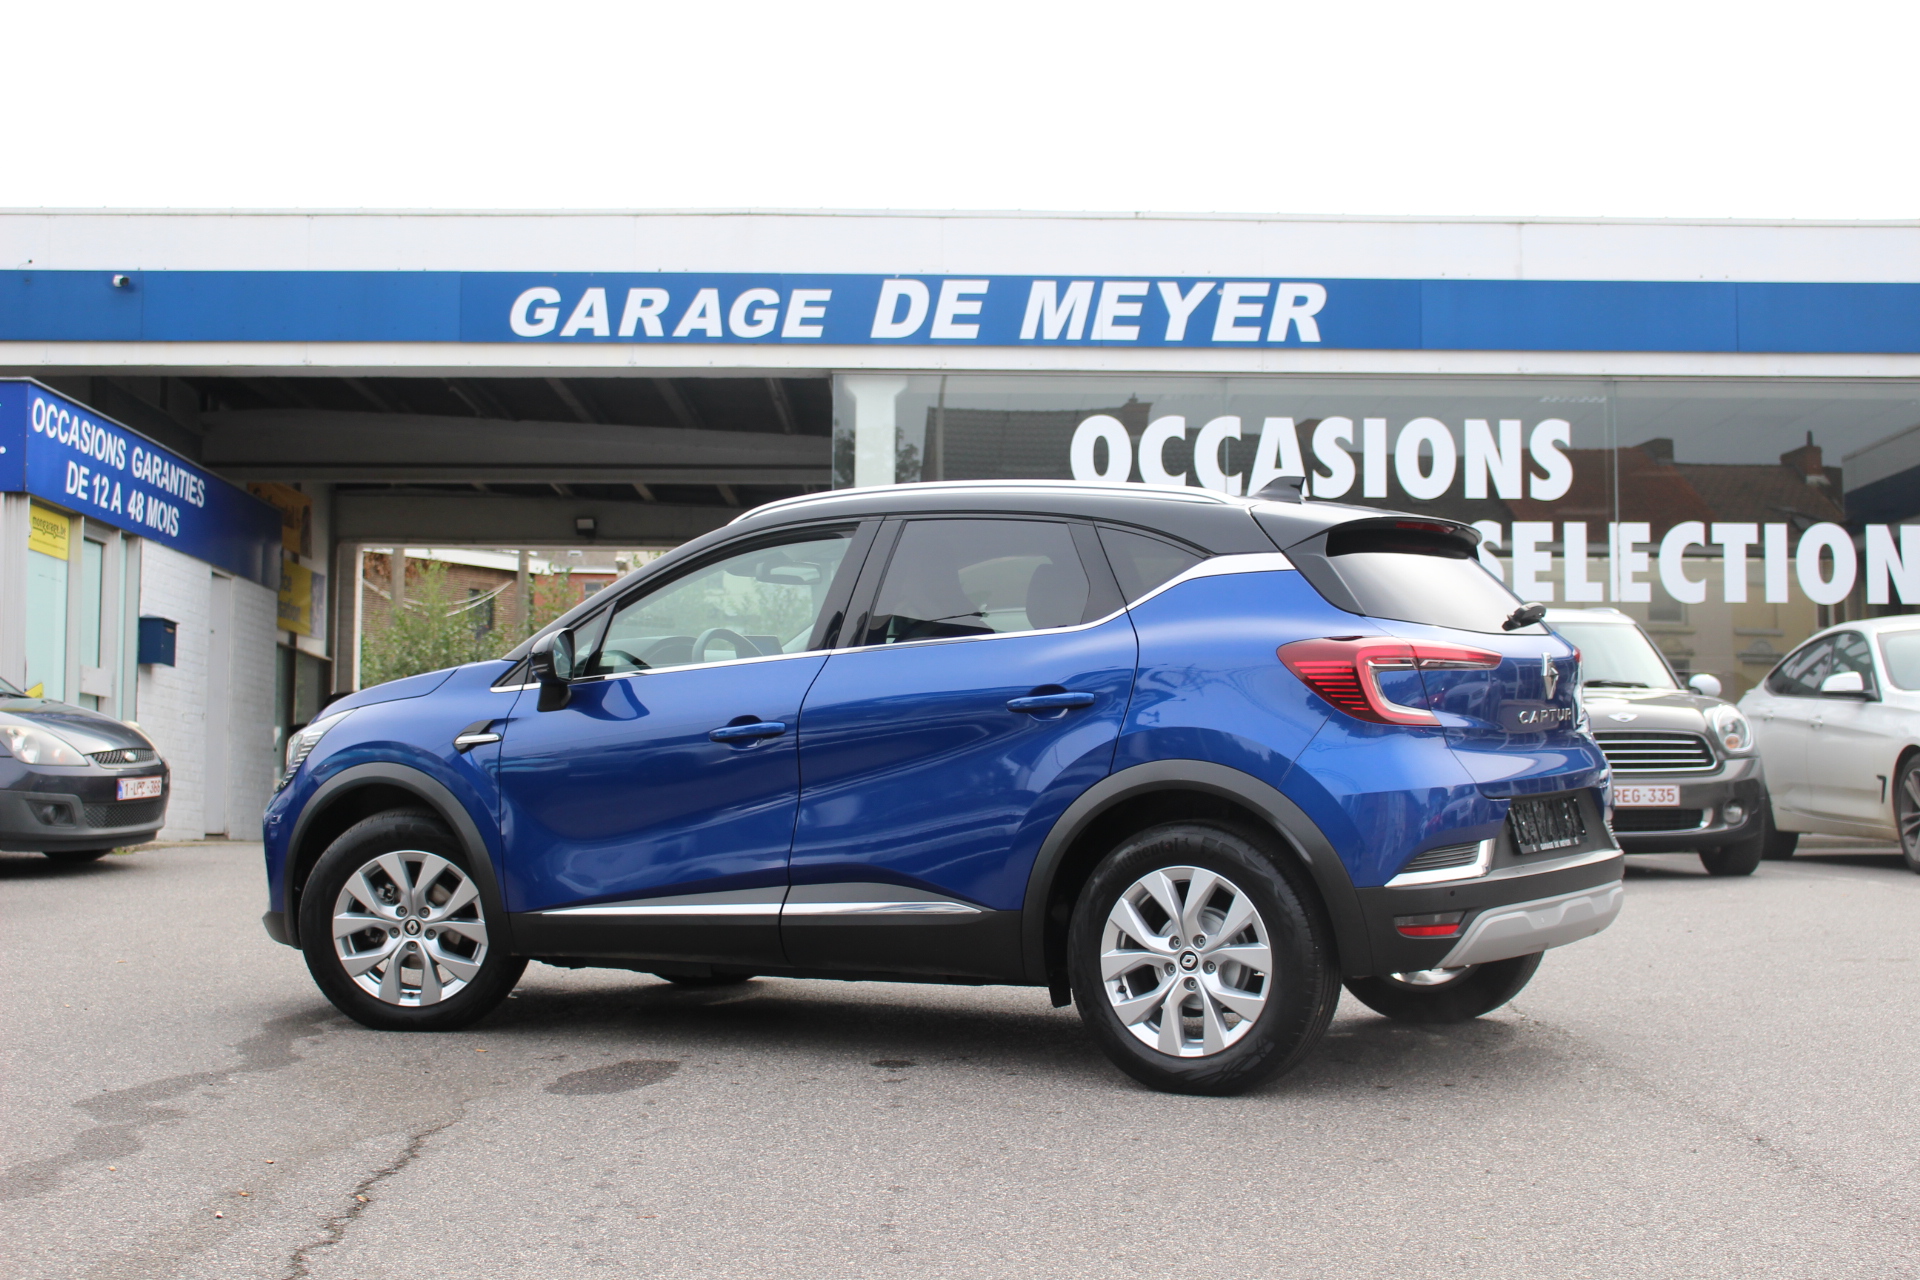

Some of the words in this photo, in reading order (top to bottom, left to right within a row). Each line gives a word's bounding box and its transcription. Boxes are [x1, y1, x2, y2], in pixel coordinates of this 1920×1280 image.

[509, 286, 833, 338] GARAGE
[869, 278, 990, 340] DE
[1018, 280, 1328, 343] MEYER
[31, 396, 127, 471] OCCASIONS
[131, 446, 206, 508] GARANTIES
[1070, 415, 1574, 501] OCCASIONS
[65, 460, 90, 500] DE
[92, 473, 109, 509] 12
[110, 482, 122, 515] A
[127, 488, 145, 523] 48
[146, 498, 180, 538] MOIS
[1518, 707, 1572, 725] CAPTUR
